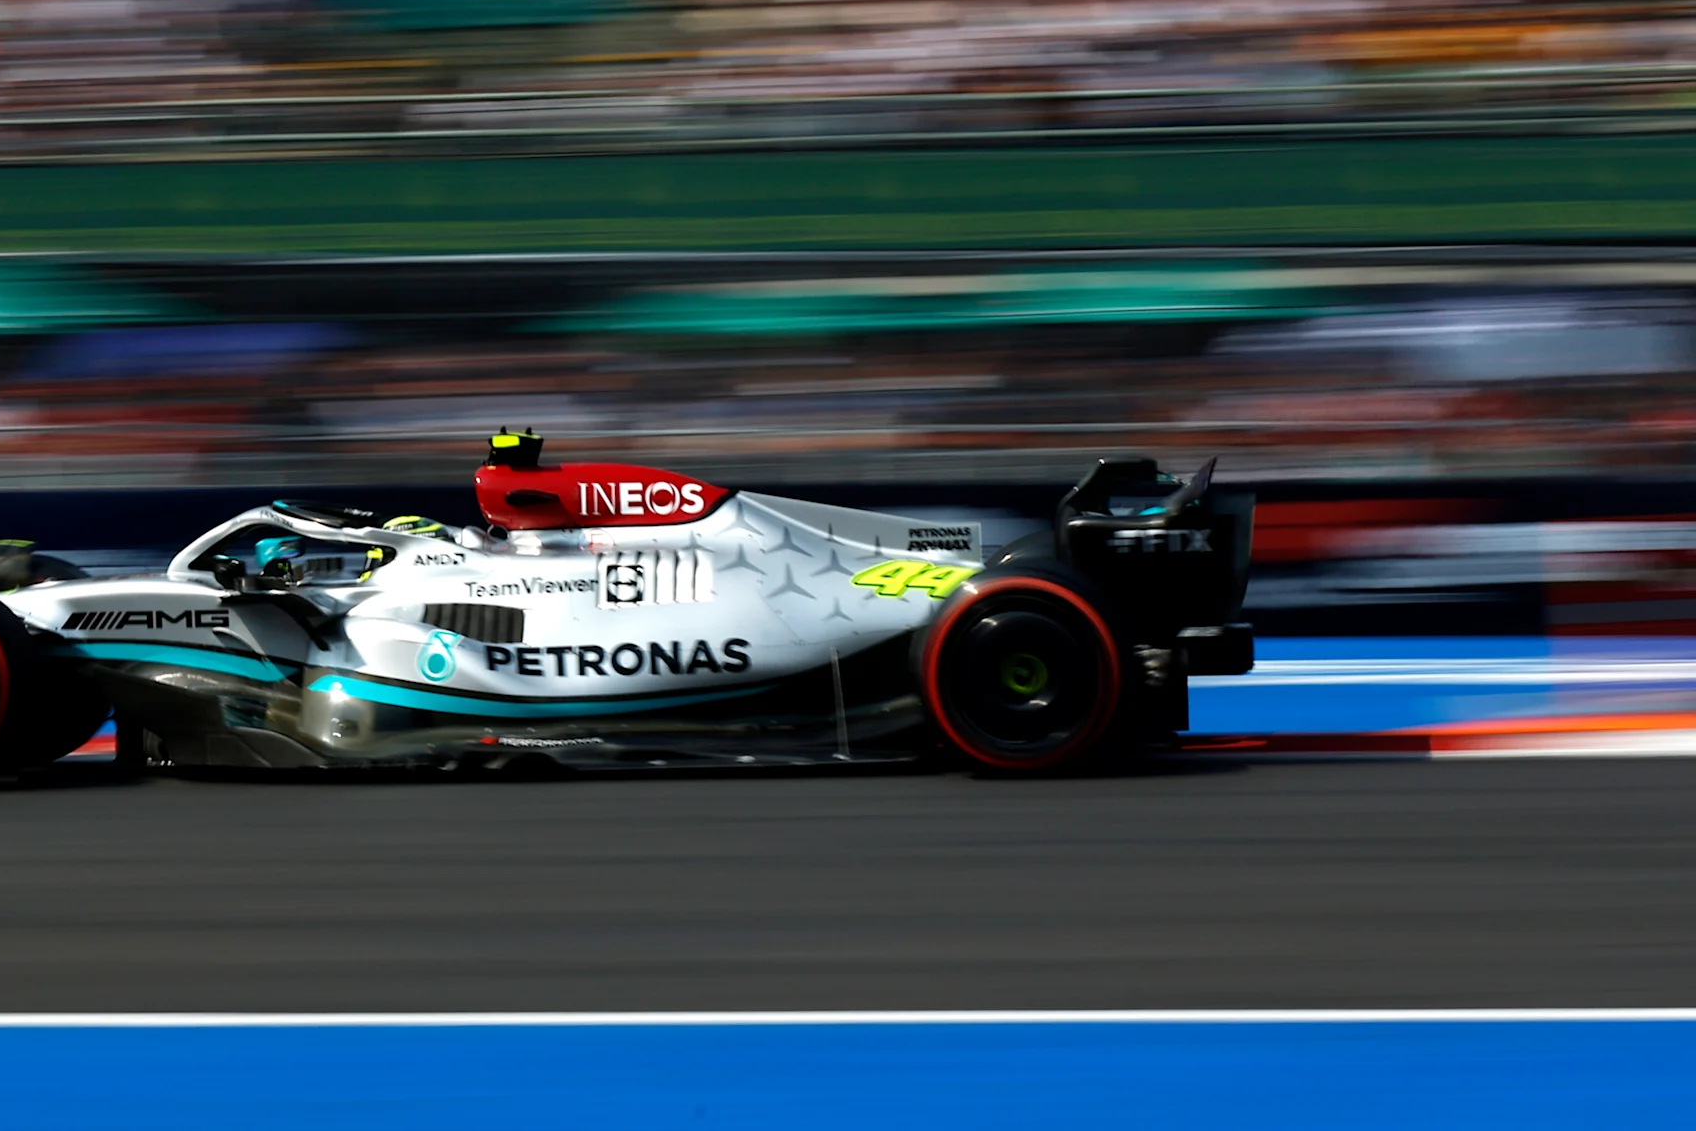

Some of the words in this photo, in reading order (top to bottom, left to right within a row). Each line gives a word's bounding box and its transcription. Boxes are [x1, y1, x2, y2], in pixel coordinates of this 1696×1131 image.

[577, 481, 705, 516] INEOS
[908, 527, 972, 538] PETRONAS
[413, 554, 453, 567] AMD
[464, 576, 599, 598] TeamViewer
[849, 559, 976, 602] 44
[115, 609, 230, 630] AMG
[485, 637, 753, 678] PETRONAS
